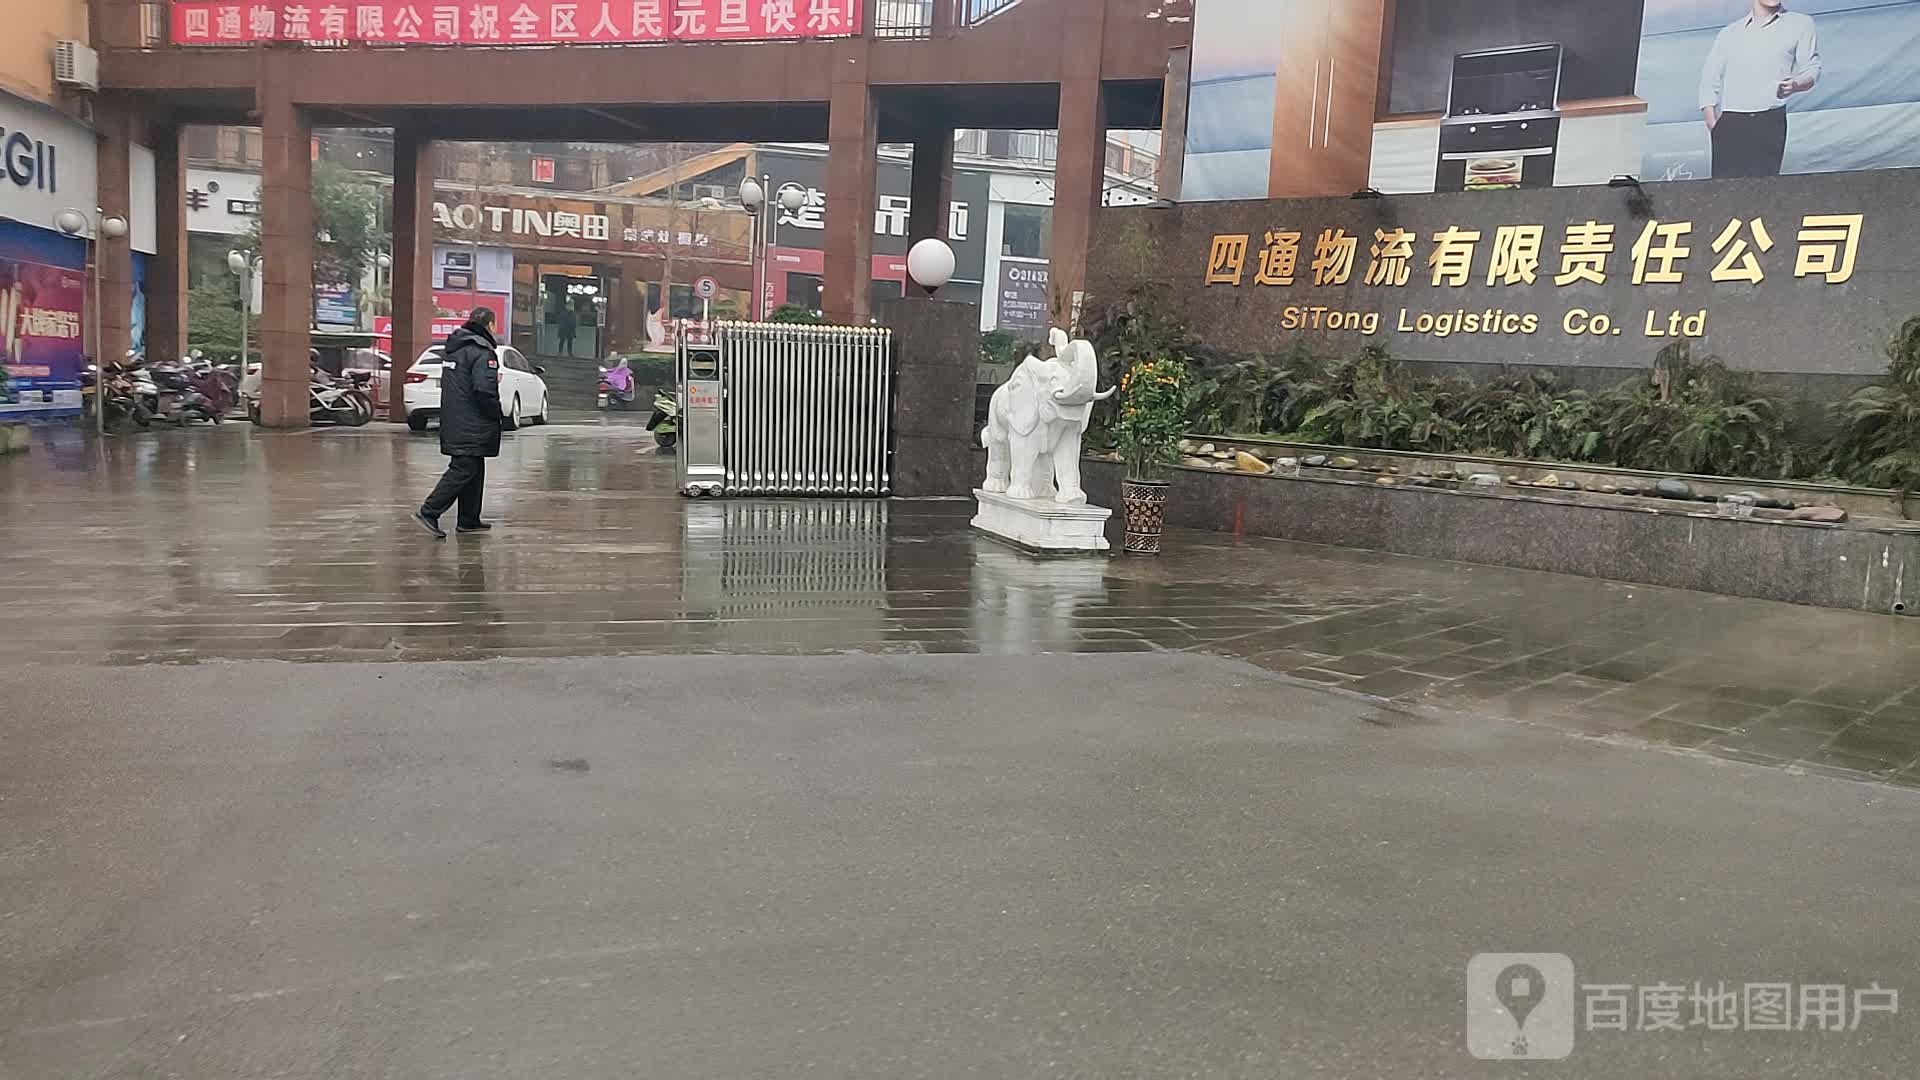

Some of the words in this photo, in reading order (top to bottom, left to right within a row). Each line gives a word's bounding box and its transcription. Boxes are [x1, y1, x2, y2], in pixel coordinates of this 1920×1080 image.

[184, 0, 855, 39] 四通物流有限公司祝全区人民元旦快乐!
[1204, 213, 1864, 287] 四通物流有限责任公司
[702, 280, 712, 292] 5
[1281, 306, 1379, 335] SiTong
[1397, 308, 1539, 337] Logistics
[1562, 308, 1622, 335] Co.
[1643, 309, 1707, 337] Ltd
